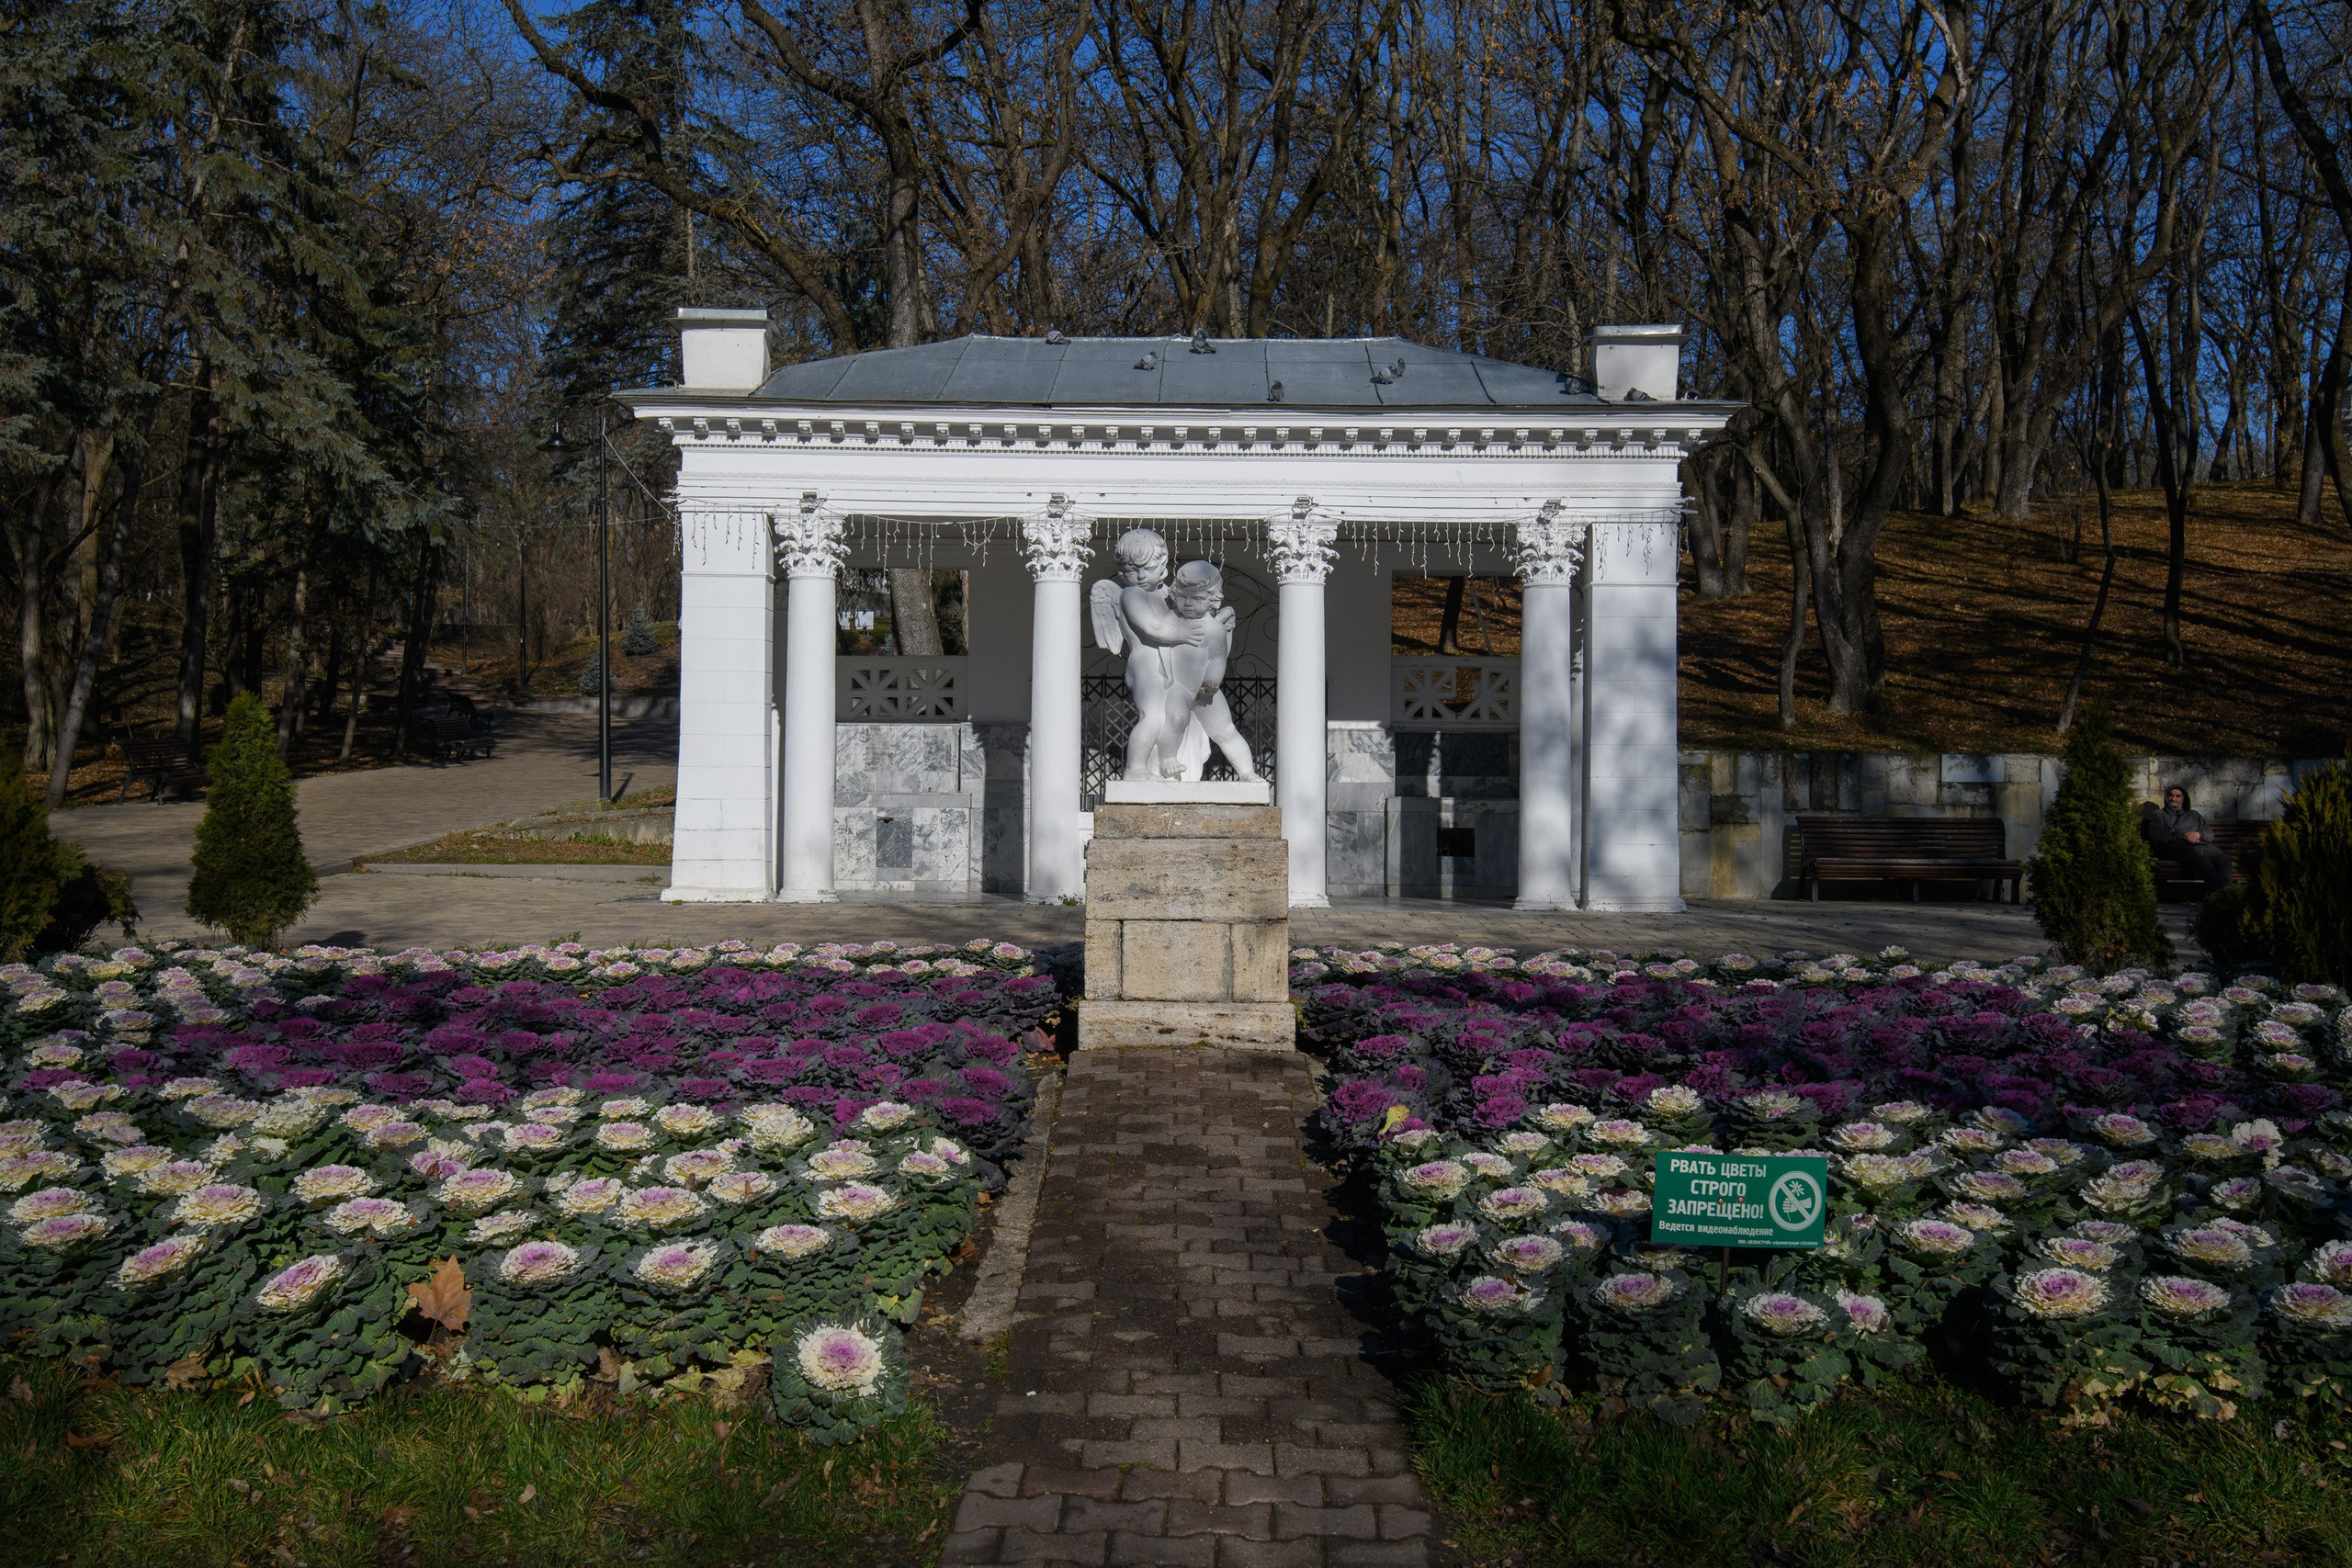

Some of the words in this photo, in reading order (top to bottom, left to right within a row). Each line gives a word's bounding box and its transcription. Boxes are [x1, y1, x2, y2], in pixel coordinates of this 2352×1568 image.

[1670, 1158, 1716, 1176] РВАТЬ
[1721, 1162, 1767, 1179] ЦВЕТЫ
[1690, 1179, 1747, 1197] СТРОГО
[1668, 1198, 1764, 1220] ЗАПРЕЩЕНО!
[1658, 1220, 1695, 1233] Ведется
[1698, 1224, 1773, 1236] видеонаблюдение
